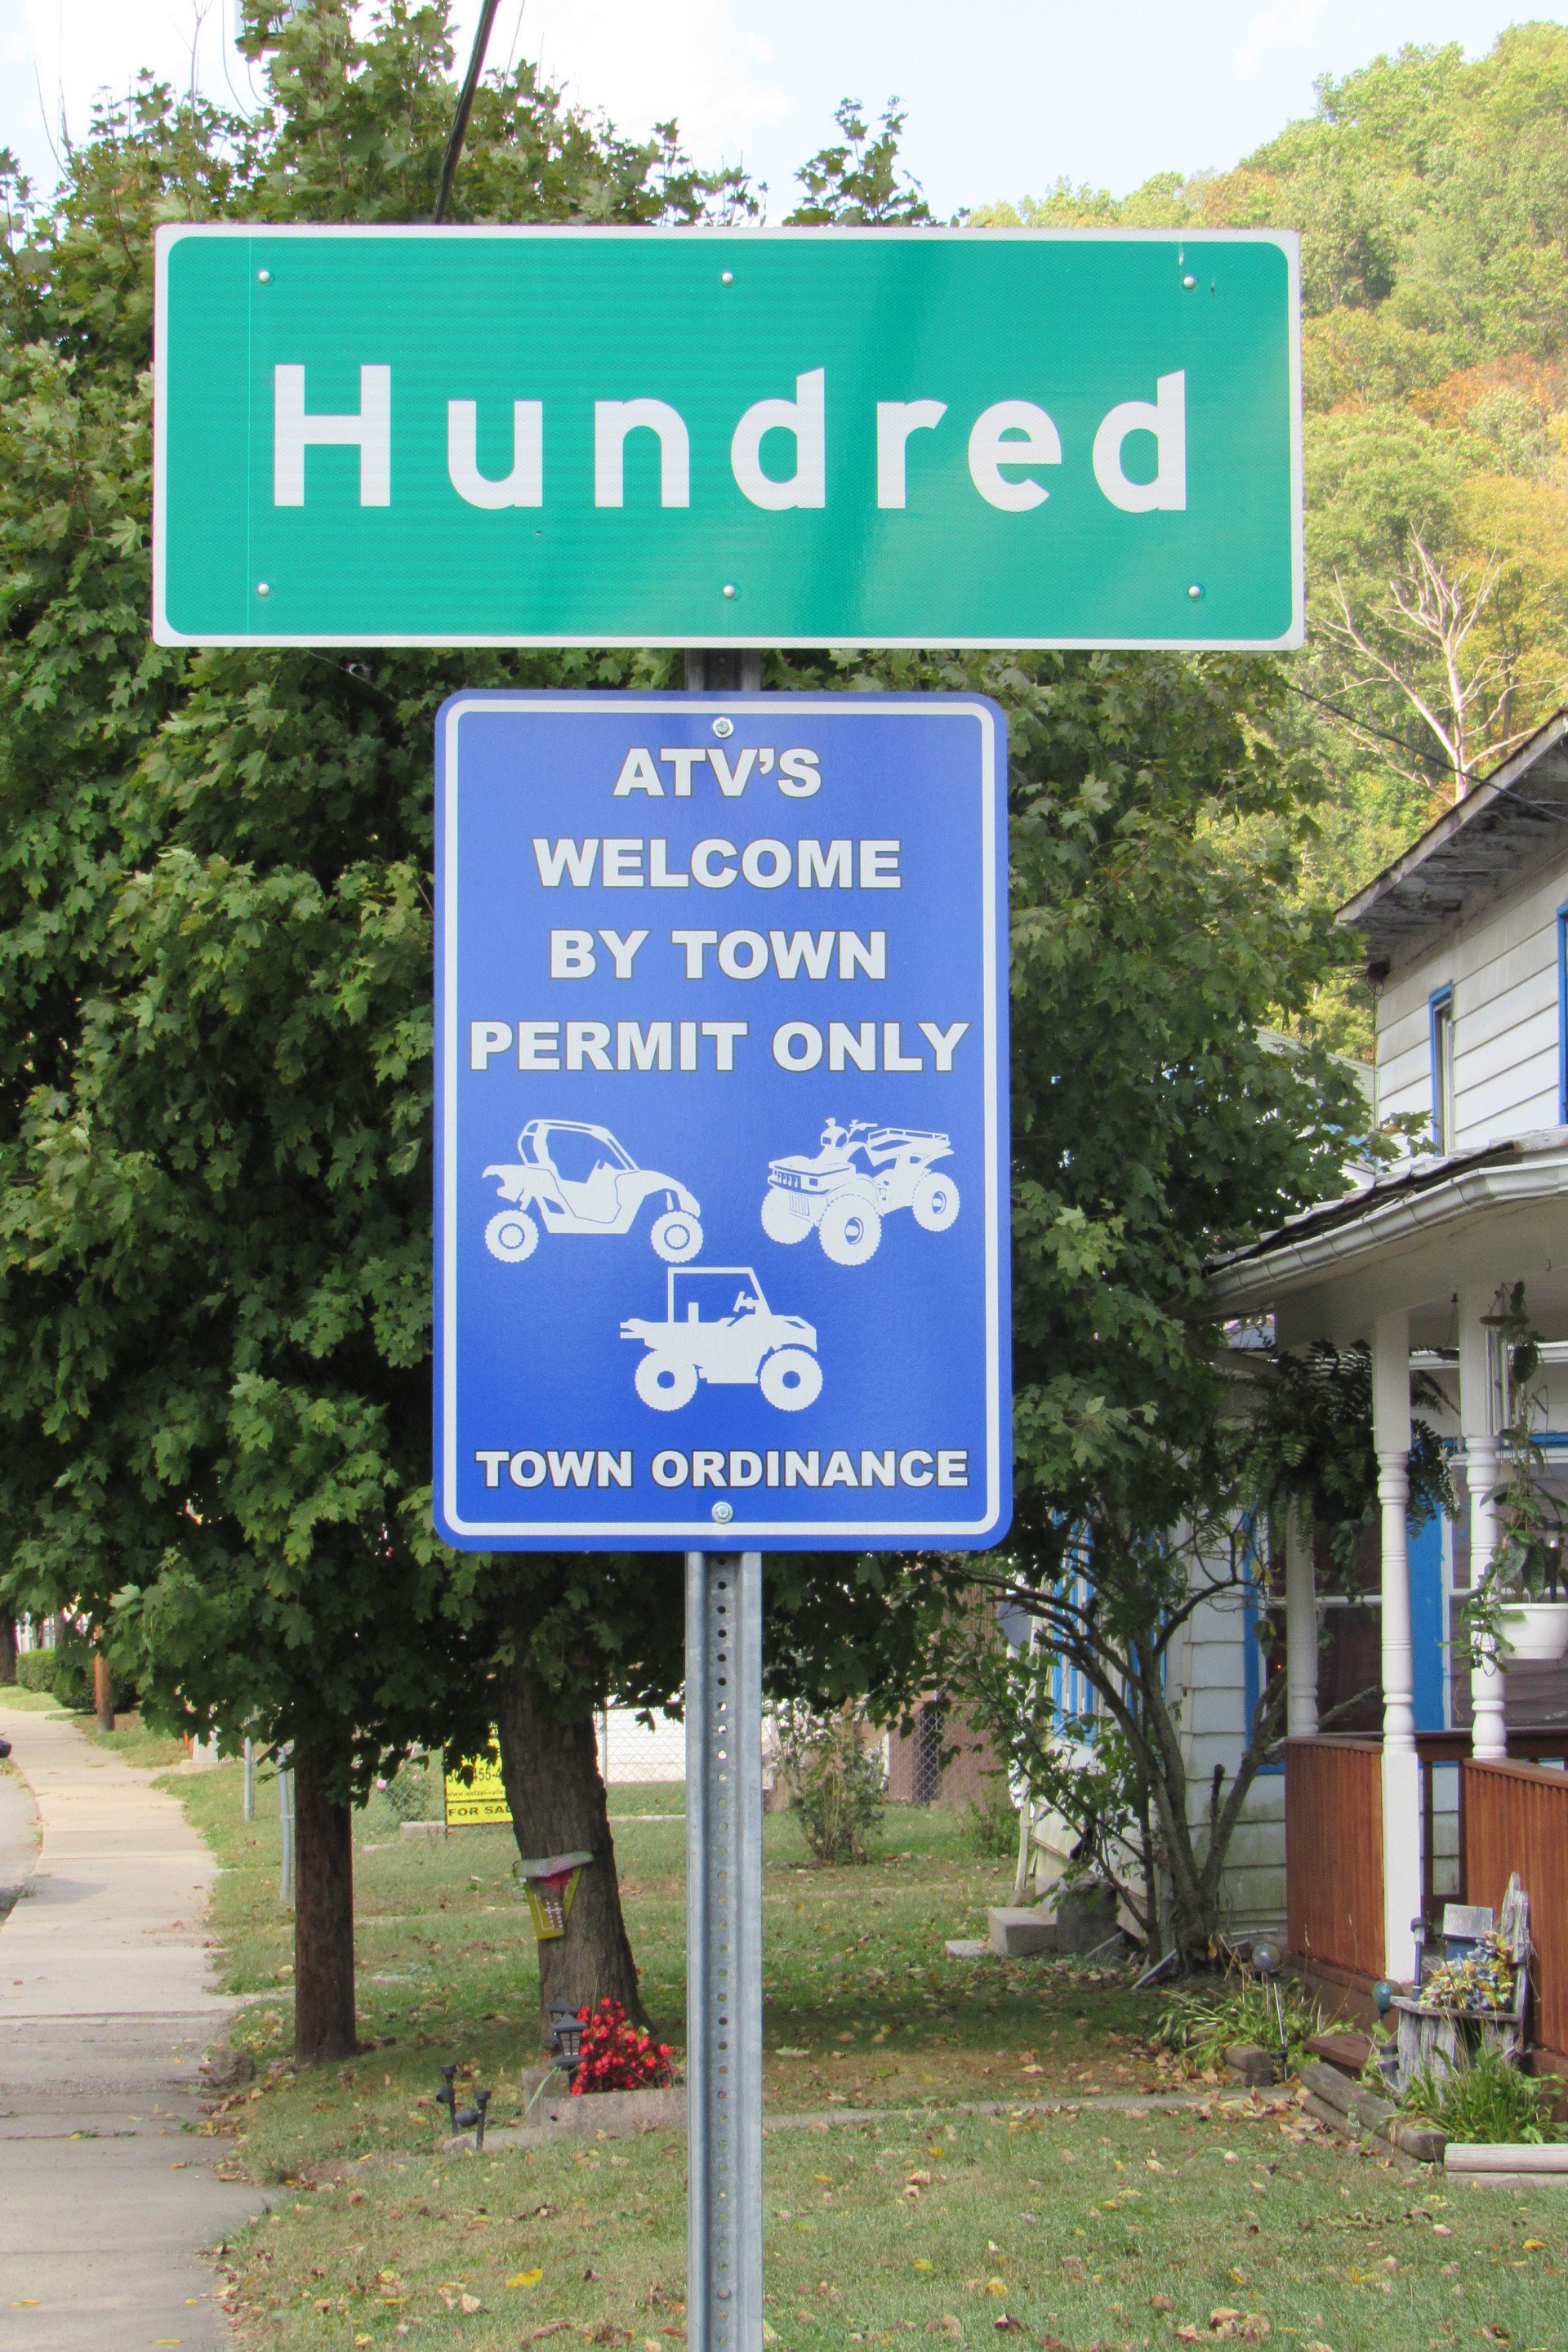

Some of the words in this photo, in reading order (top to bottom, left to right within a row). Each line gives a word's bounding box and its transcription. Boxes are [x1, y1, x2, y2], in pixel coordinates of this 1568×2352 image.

[273, 364, 1187, 513] Hundred
[613, 748, 822, 798] ATV'S
[532, 838, 901, 889] WELCOME
[550, 929, 648, 978] BY
[671, 929, 886, 979] TOWN
[470, 1021, 747, 1071] PERMIT
[772, 1021, 969, 1071] ONLY
[475, 1450, 633, 1488] TOWN
[651, 1450, 969, 1488] ORDINANCE
[448, 1806, 479, 1817] FOR
[484, 1804, 512, 1814] SAL
